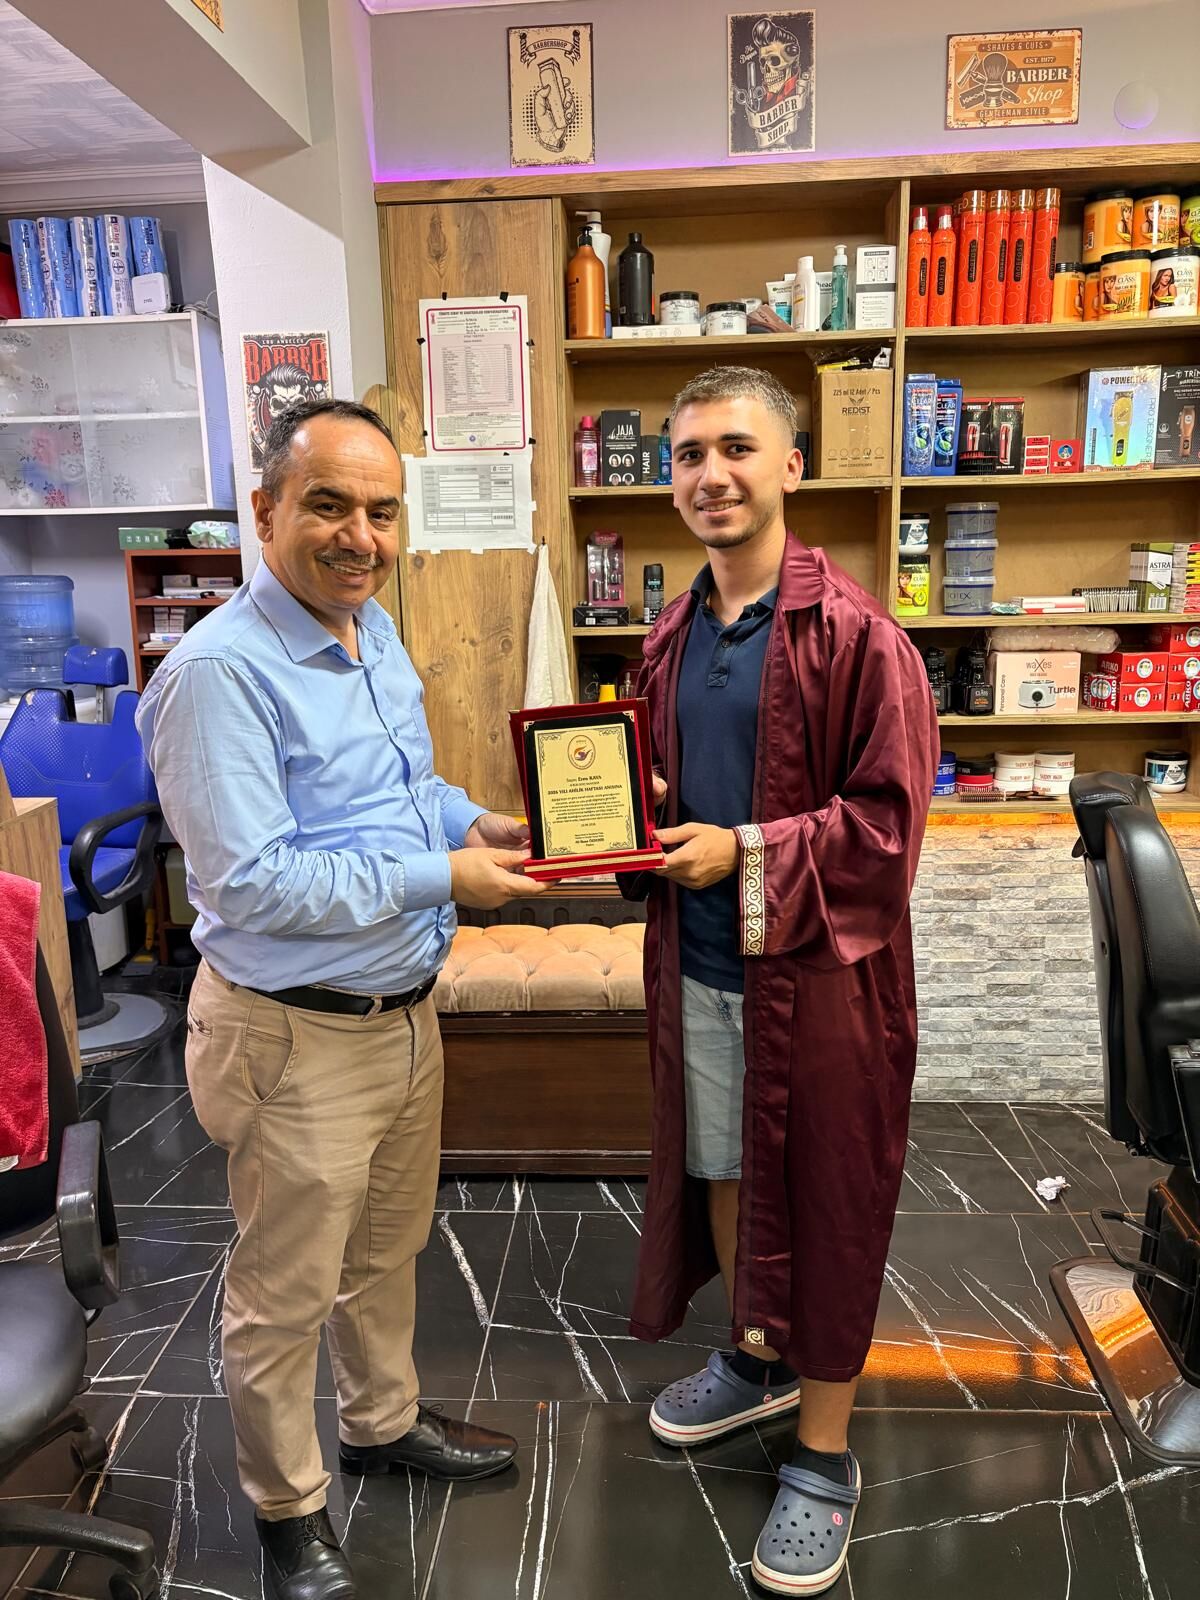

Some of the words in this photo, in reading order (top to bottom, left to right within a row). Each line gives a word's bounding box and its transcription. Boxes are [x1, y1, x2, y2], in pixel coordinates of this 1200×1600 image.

[533, 40, 567, 50] BARBERSHOP
[987, 43, 1015, 51] SHAVES
[1025, 41, 1044, 50] CUTS
[1006, 68, 1069, 83] BARBER
[1023, 84, 1064, 105] Shop
[759, 98, 798, 127] BARBER
[979, 108, 1021, 118] GENTLEMAN
[1025, 107, 1046, 116] STYLE
[767, 121, 789, 142] SHOP
[243, 340, 328, 385] BARBER
[842, 406, 871, 415] REDIST
[937, 402, 956, 410] CLEAR
[616, 424, 634, 436] JAJA
[1145, 418, 1154, 458] DESIGNER
[642, 451, 650, 474] HAIR
[1101, 660, 1119, 672] ARKO
[1048, 685, 1076, 694] Turtle
[1184, 680, 1192, 708] ARKO
